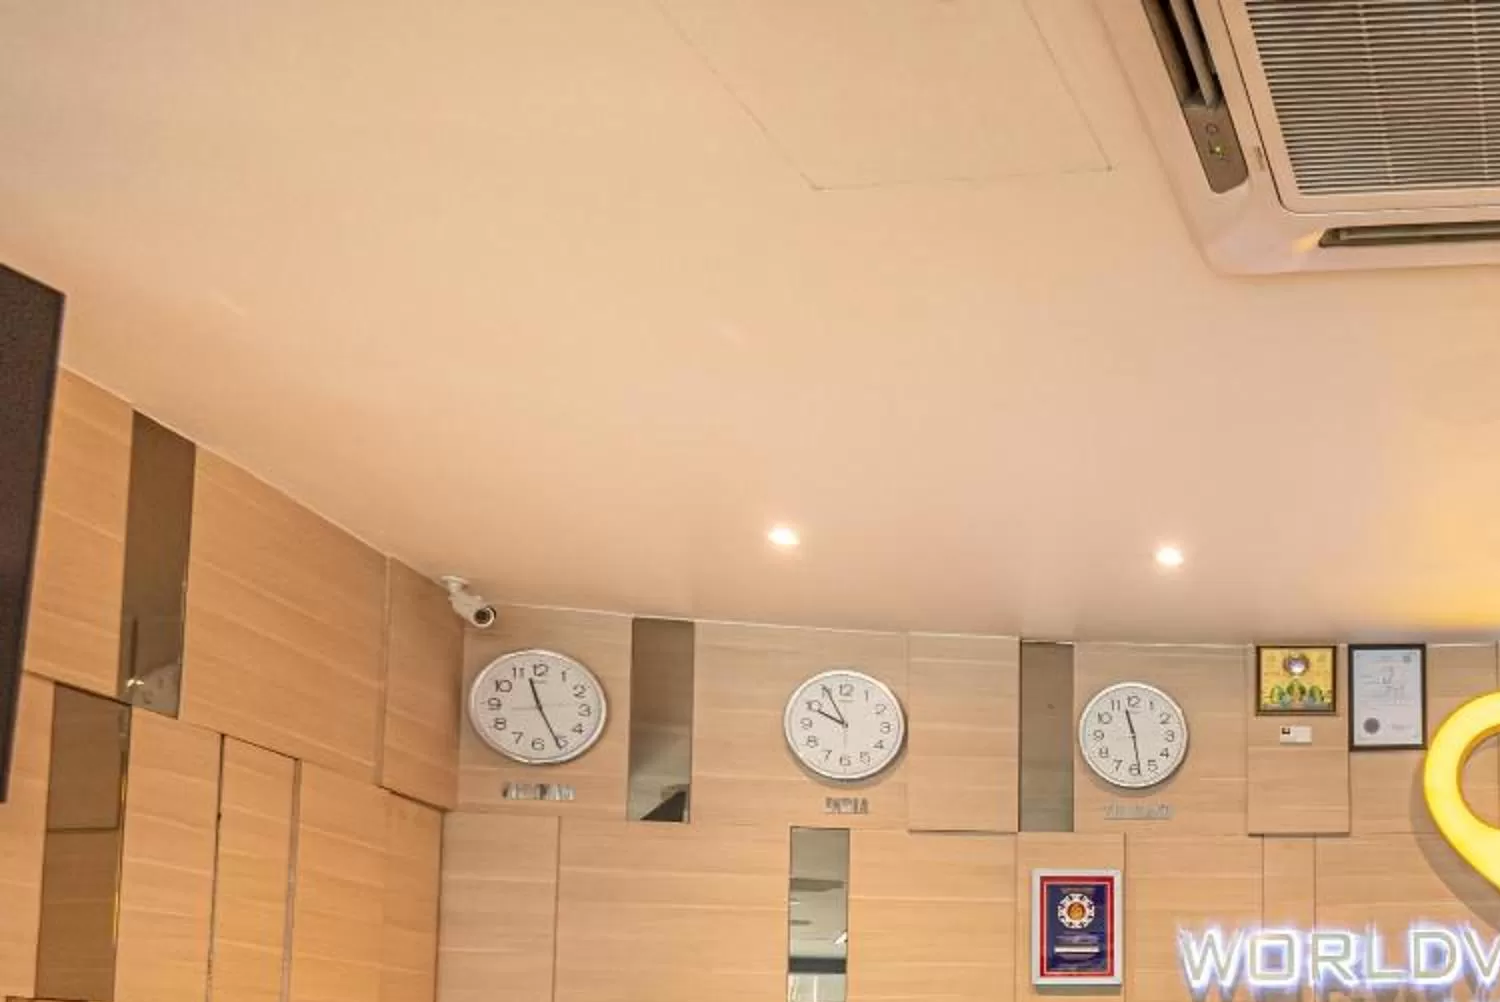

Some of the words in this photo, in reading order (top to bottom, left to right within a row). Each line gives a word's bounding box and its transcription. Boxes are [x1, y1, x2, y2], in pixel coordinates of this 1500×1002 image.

[512, 667, 525, 678] 11
[533, 664, 548, 676] 12
[495, 680, 512, 692] 10
[573, 685, 586, 698] 2
[839, 684, 854, 696] 12
[488, 698, 502, 710] 9
[1111, 700, 1120, 711] 11
[1127, 696, 1140, 707] 12
[579, 704, 591, 717] 3
[875, 704, 887, 715] 2
[494, 718, 506, 730] 8
[800, 718, 813, 730] 9
[1098, 712, 1112, 724] 10
[1160, 712, 1171, 724] 2
[572, 724, 584, 734] 4
[880, 722, 891, 734] 3
[512, 732, 523, 744] 7
[1094, 730, 1104, 741] 9
[1165, 730, 1175, 742] 3
[532, 738, 544, 750] 6
[806, 736, 818, 748] 8
[873, 740, 884, 749] 4
[820, 750, 832, 761] 7
[1100, 747, 1108, 758] 8
[1160, 748, 1170, 758] 4
[840, 755, 851, 766] 6
[860, 752, 870, 766] 5
[1113, 759, 1123, 771] 7
[1148, 760, 1158, 772] 5
